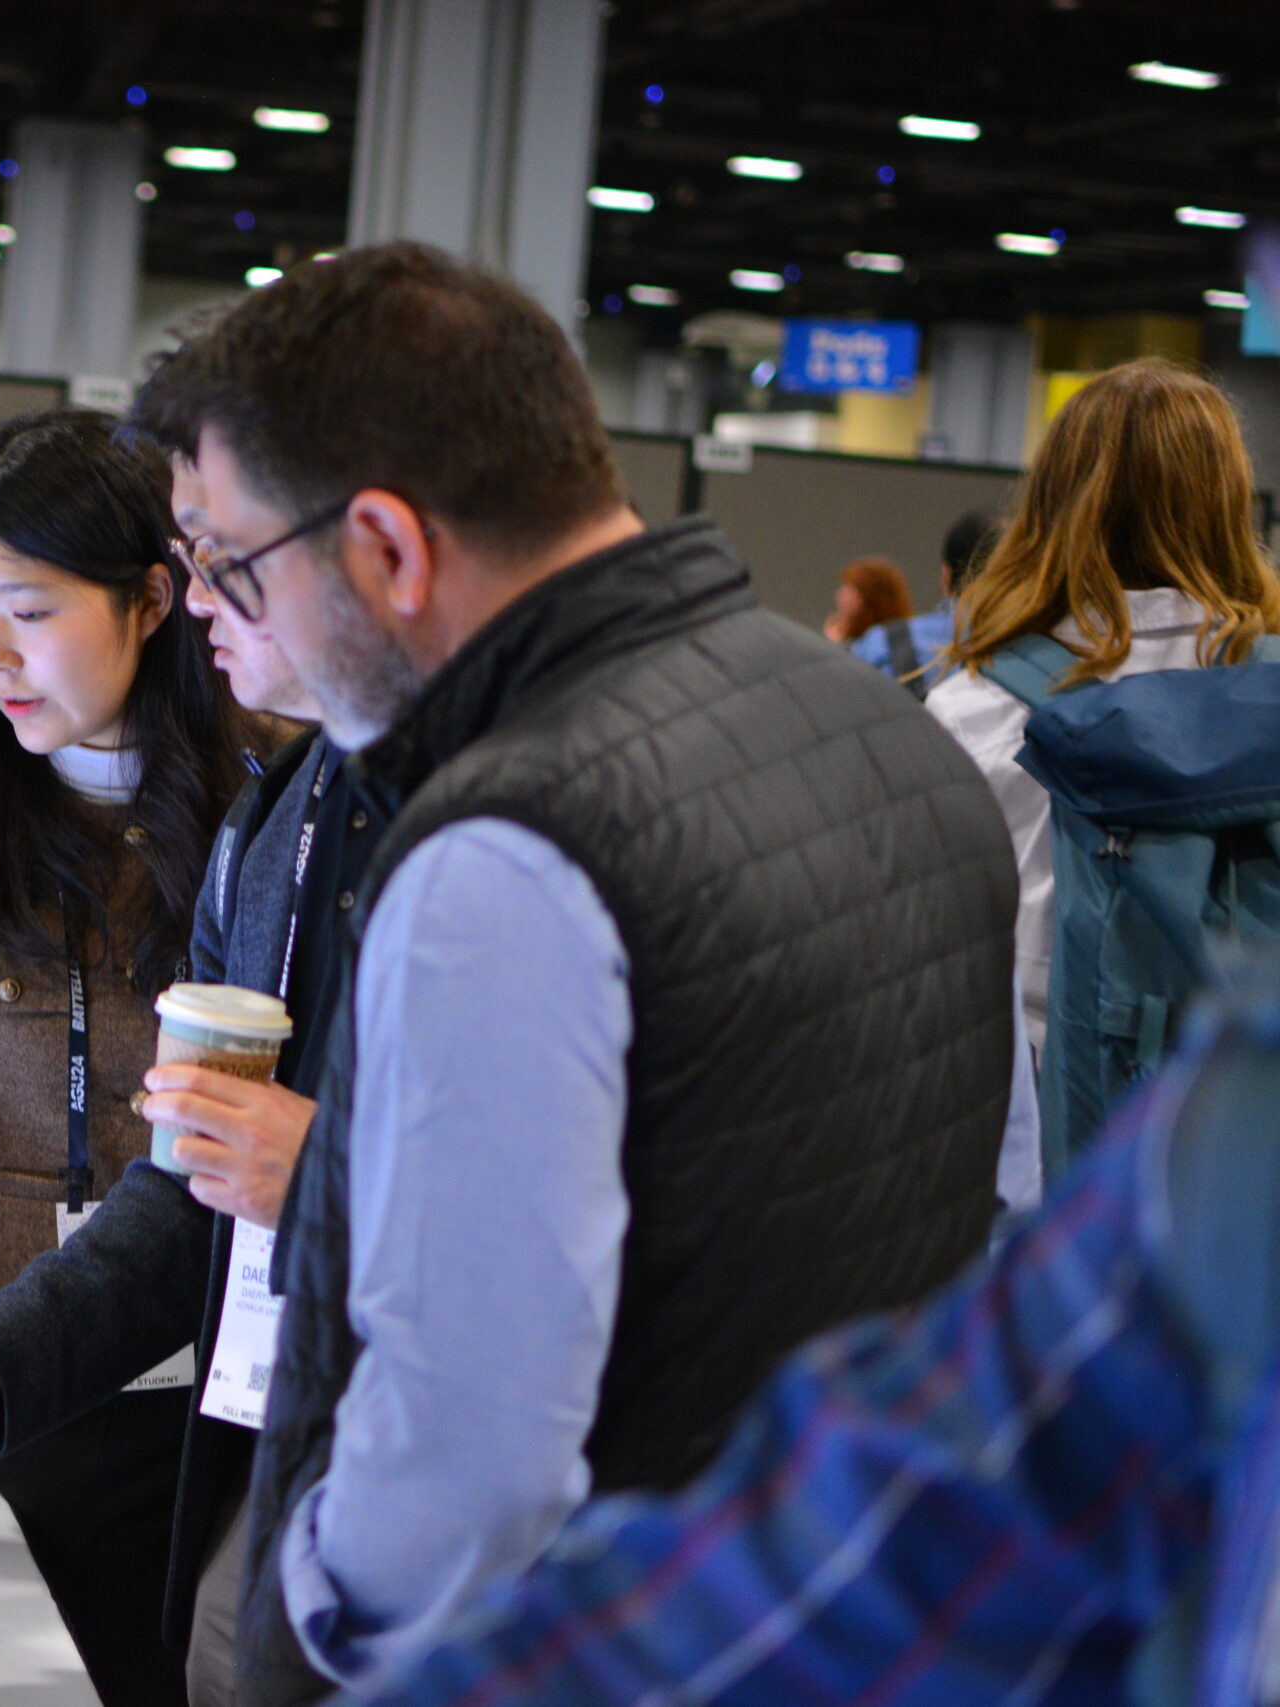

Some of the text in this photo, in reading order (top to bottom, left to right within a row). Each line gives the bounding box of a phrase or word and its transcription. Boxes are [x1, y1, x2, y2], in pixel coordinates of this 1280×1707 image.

[295, 822, 316, 886] AGU24
[71, 1055, 84, 1113] AGU24
[242, 1264, 269, 1285] DAE
[137, 1375, 179, 1387] STUDENT
